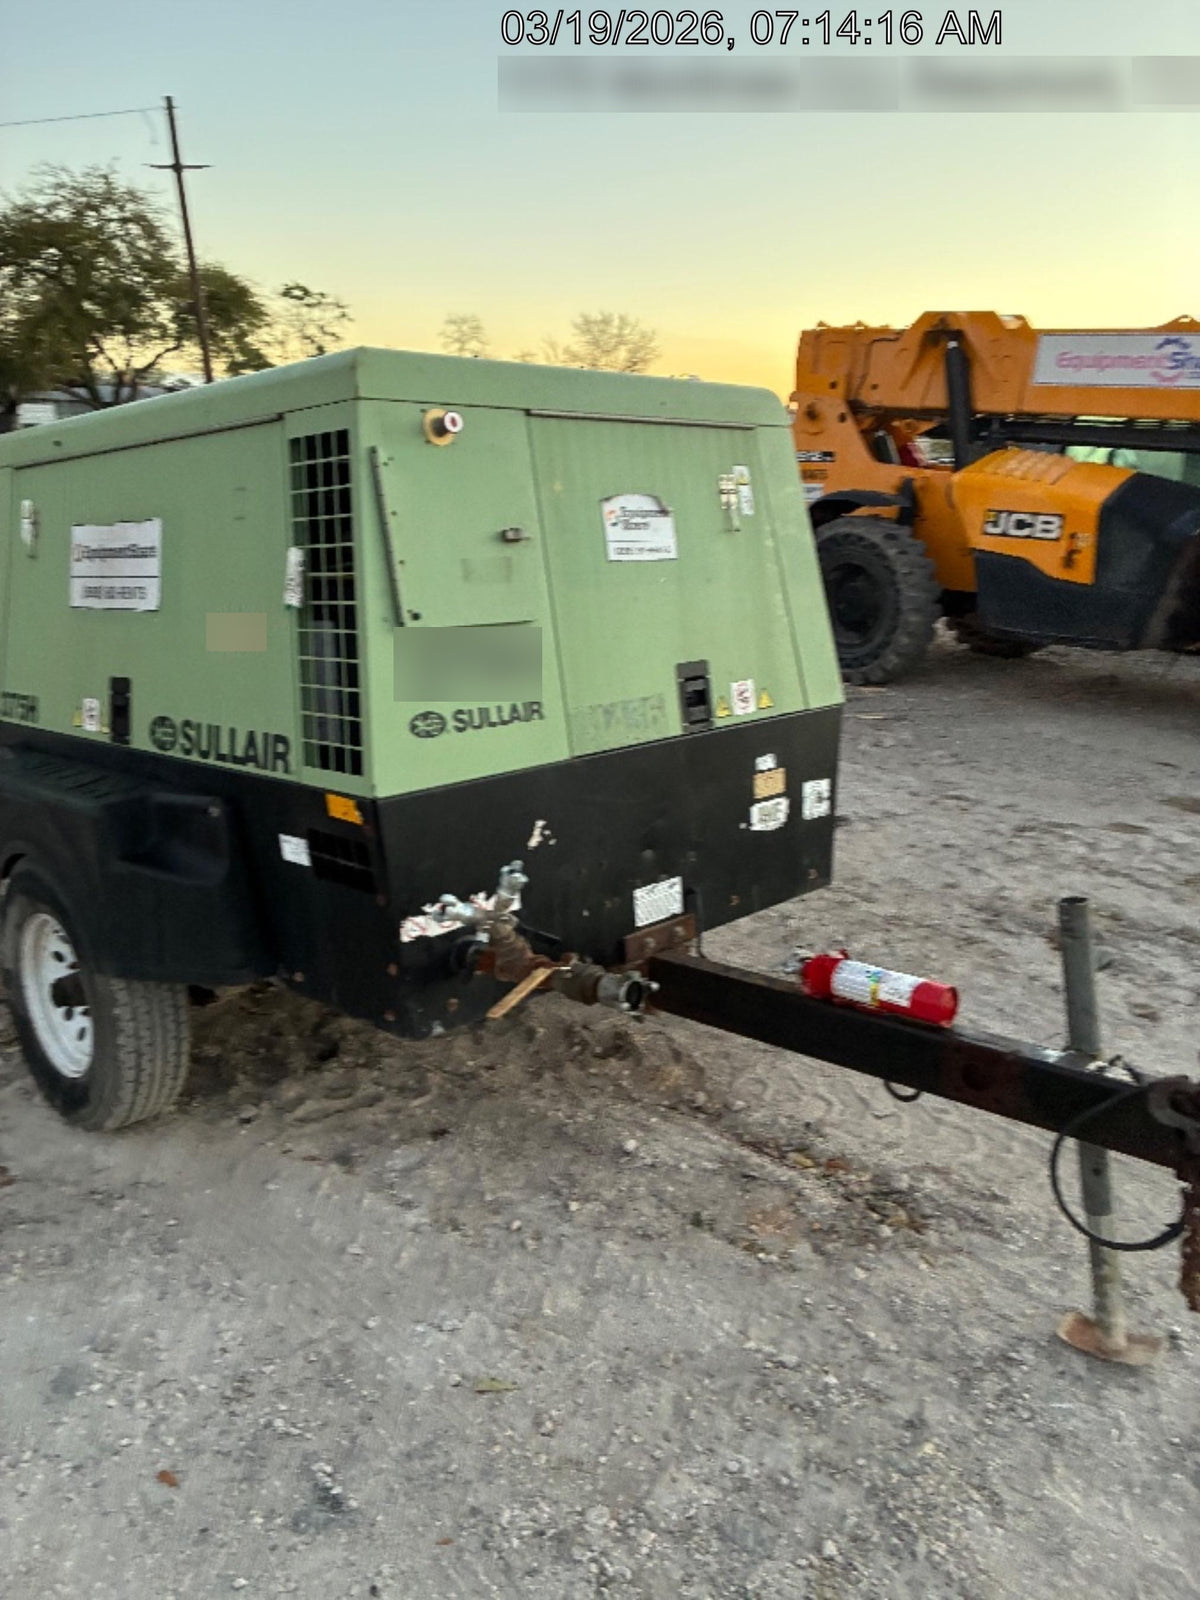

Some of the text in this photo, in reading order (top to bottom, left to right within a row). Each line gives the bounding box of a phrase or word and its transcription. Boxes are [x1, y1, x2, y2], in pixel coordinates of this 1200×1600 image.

[983, 510, 1063, 540] JCB
[452, 701, 544, 733] SULLAIR
[181, 718, 290, 774] SULLAIR
